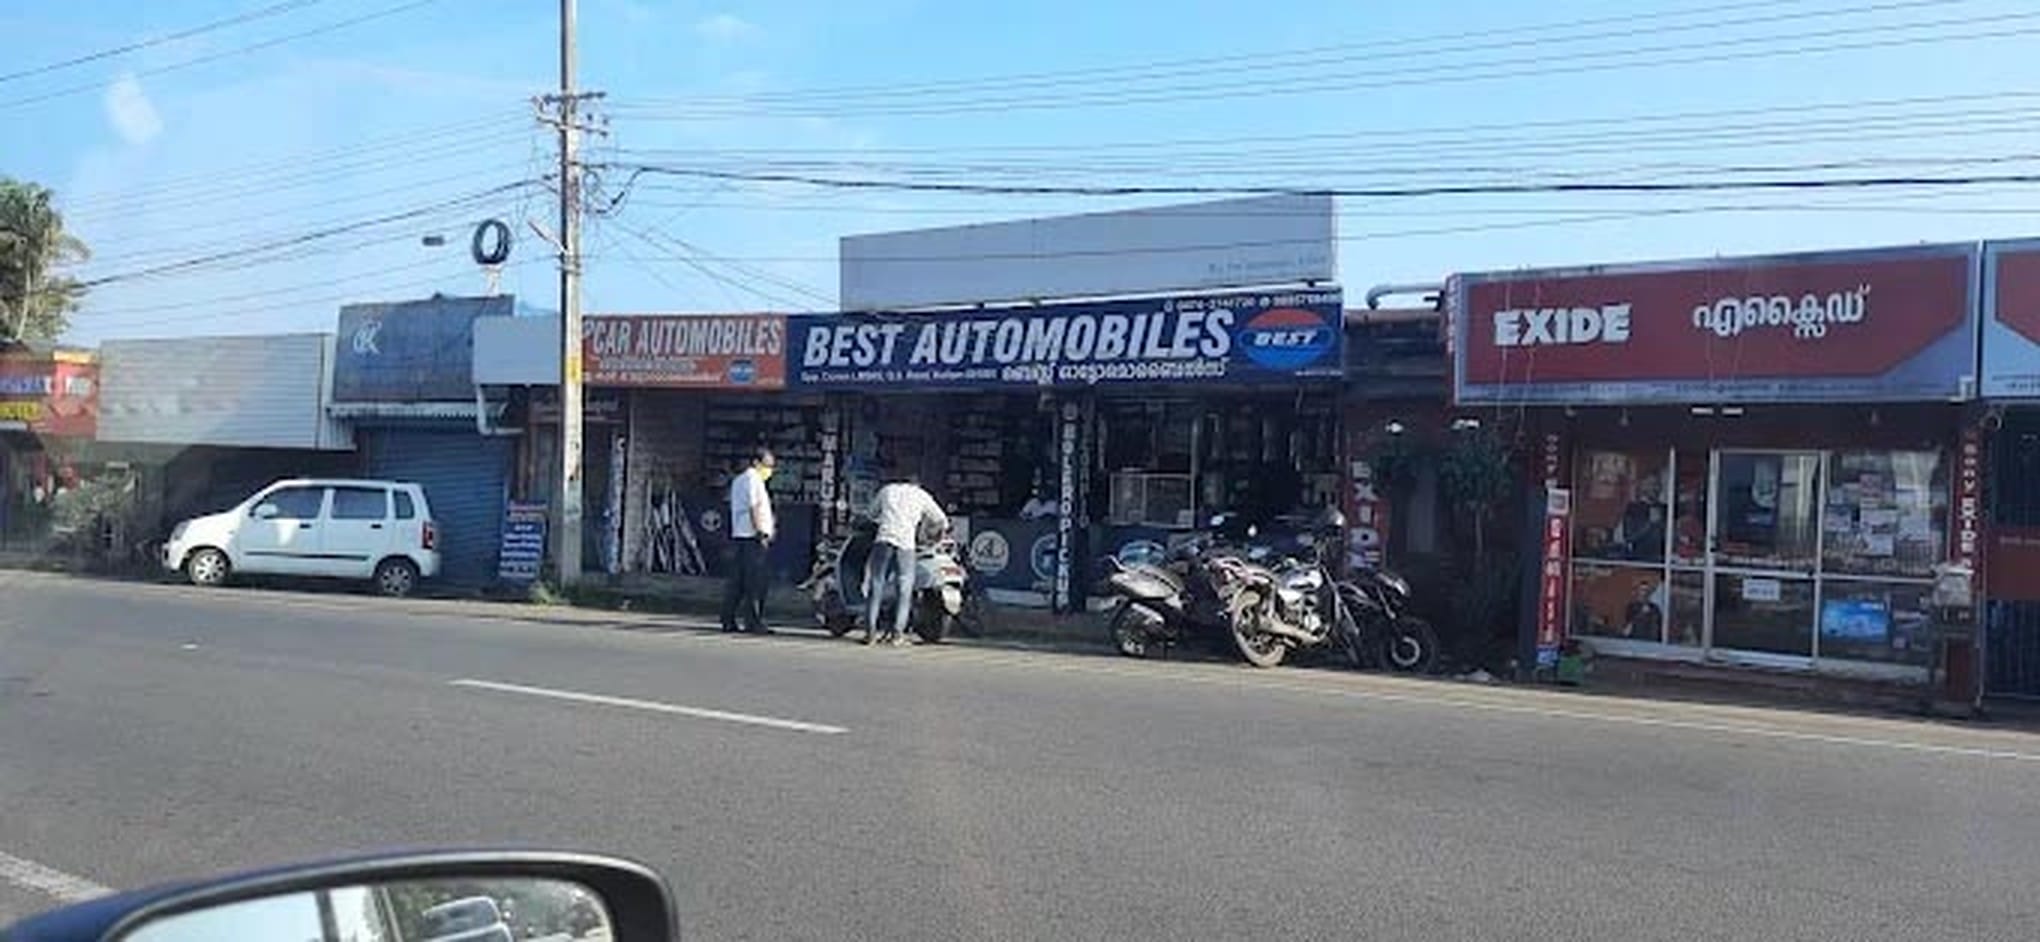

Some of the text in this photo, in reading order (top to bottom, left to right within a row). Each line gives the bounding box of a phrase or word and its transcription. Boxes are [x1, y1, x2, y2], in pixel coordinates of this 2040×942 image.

[636, 318, 781, 356] AUTOMOBILES
[804, 308, 1234, 367] BEST AUTOMOBILES
[1253, 329, 1317, 347] BEST
[1494, 303, 1632, 346] EXIDE
[1350, 461, 1381, 570] EXIDE
[1960, 497, 1977, 553] EXIDE
